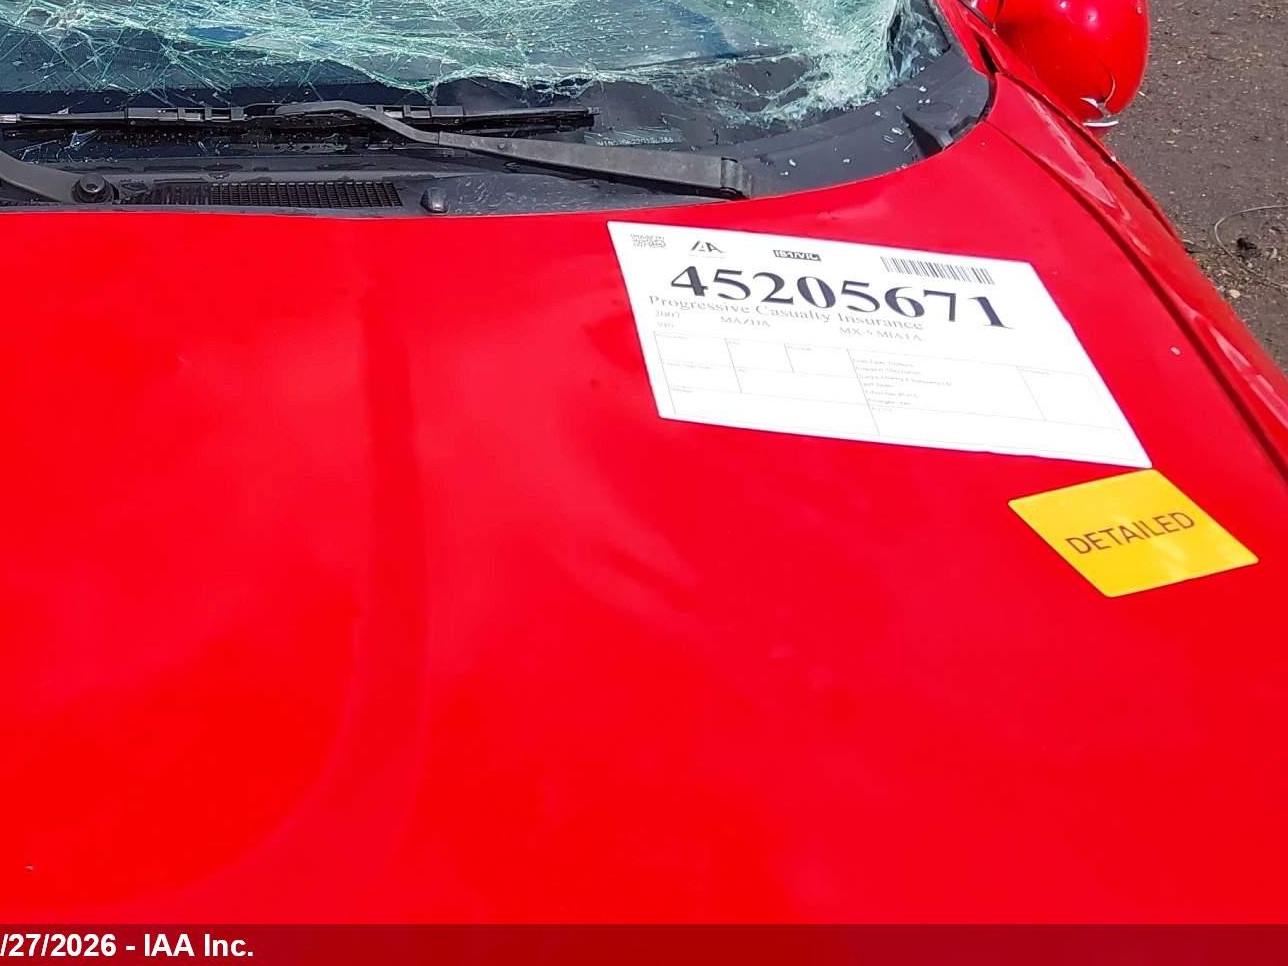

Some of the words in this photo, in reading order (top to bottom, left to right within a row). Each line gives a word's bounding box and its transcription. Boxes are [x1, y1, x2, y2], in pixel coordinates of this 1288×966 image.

[649, 295, 751, 313] Progressive
[756, 305, 831, 323] Casualty
[838, 312, 924, 330] Insurance
[671, 265, 1014, 329] 45205671
[1065, 512, 1195, 554] DETAILED
